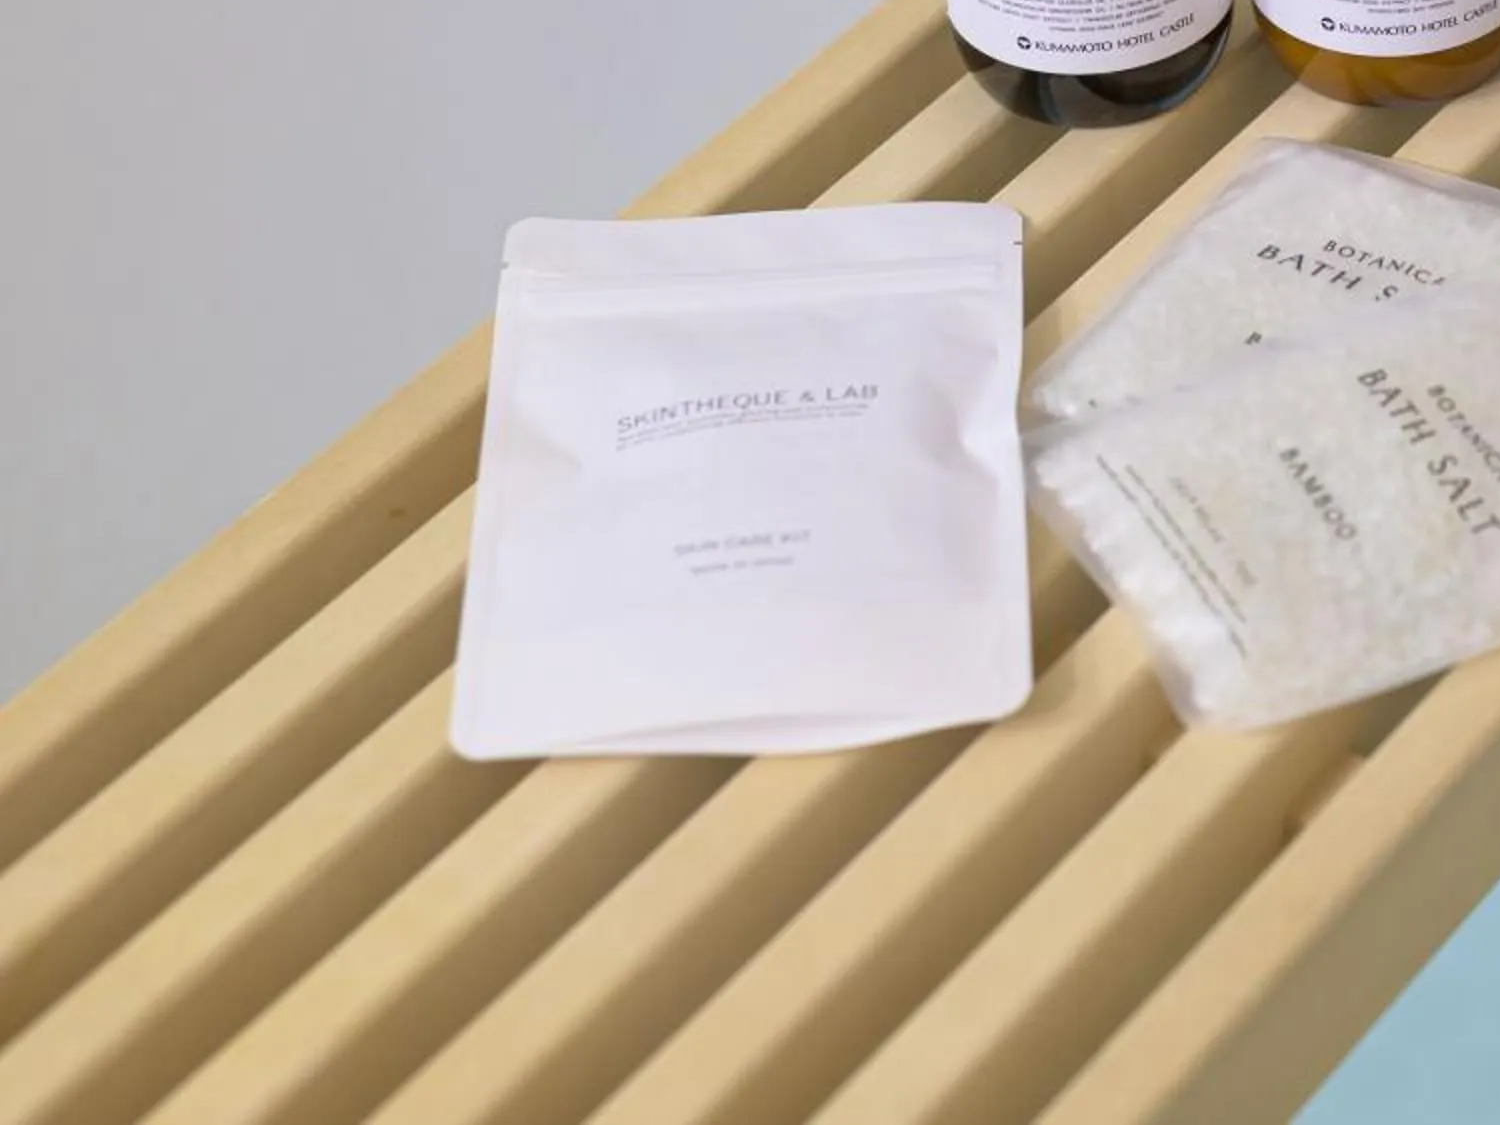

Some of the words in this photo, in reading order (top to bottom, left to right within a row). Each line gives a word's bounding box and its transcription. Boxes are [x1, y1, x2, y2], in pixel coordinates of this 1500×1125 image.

[1035, 39, 1113, 55] KUMAMOTO
[1117, 32, 1155, 52] HOTEL
[1159, 13, 1195, 36] CASTLE
[1339, 22, 1417, 36] KUMAMOTO
[1422, 16, 1458, 33] HOTEL
[1257, 244, 1363, 291] BATH
[617, 389, 791, 432] SKINTHEQUE
[800, 390, 815, 403] &
[825, 384, 879, 402] LAB
[1357, 368, 1437, 445] BATH
[1280, 447, 1358, 541] BAMBOO
